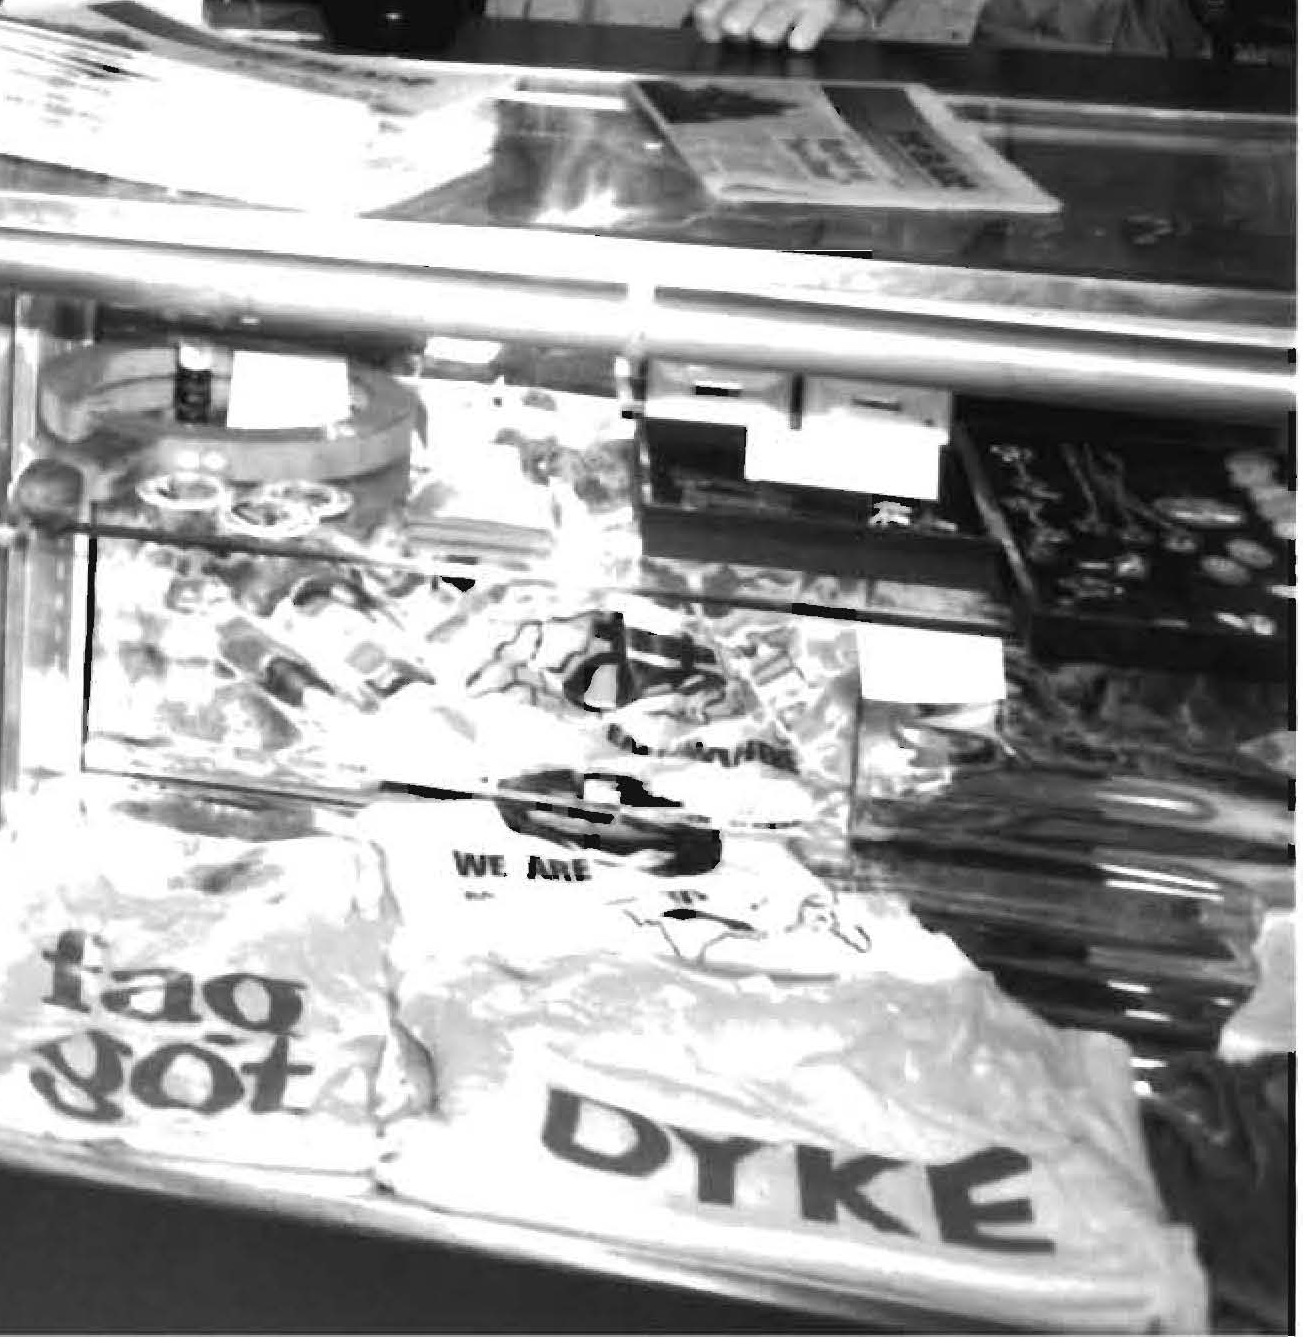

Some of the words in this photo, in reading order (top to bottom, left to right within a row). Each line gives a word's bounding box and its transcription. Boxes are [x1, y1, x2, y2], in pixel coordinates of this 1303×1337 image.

[451, 850, 506, 878] WE
[526, 854, 594, 883] ARE
[541, 1086, 1056, 1255] DYKE
